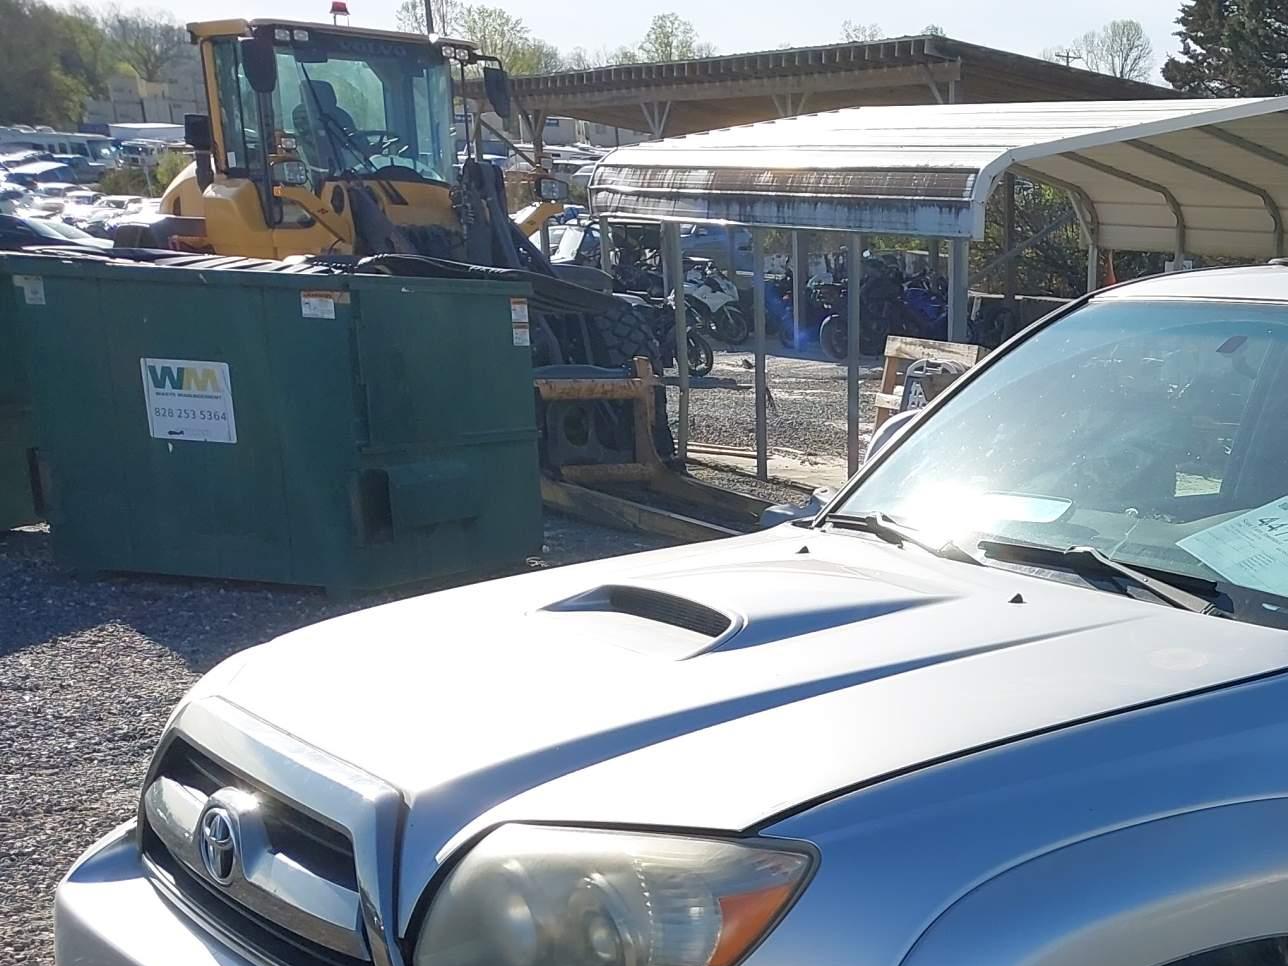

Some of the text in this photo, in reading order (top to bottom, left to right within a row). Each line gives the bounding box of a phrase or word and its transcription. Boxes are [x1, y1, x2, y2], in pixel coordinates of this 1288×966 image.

[147, 365, 223, 392] WM
[154, 407, 227, 421] 828 253 5364
